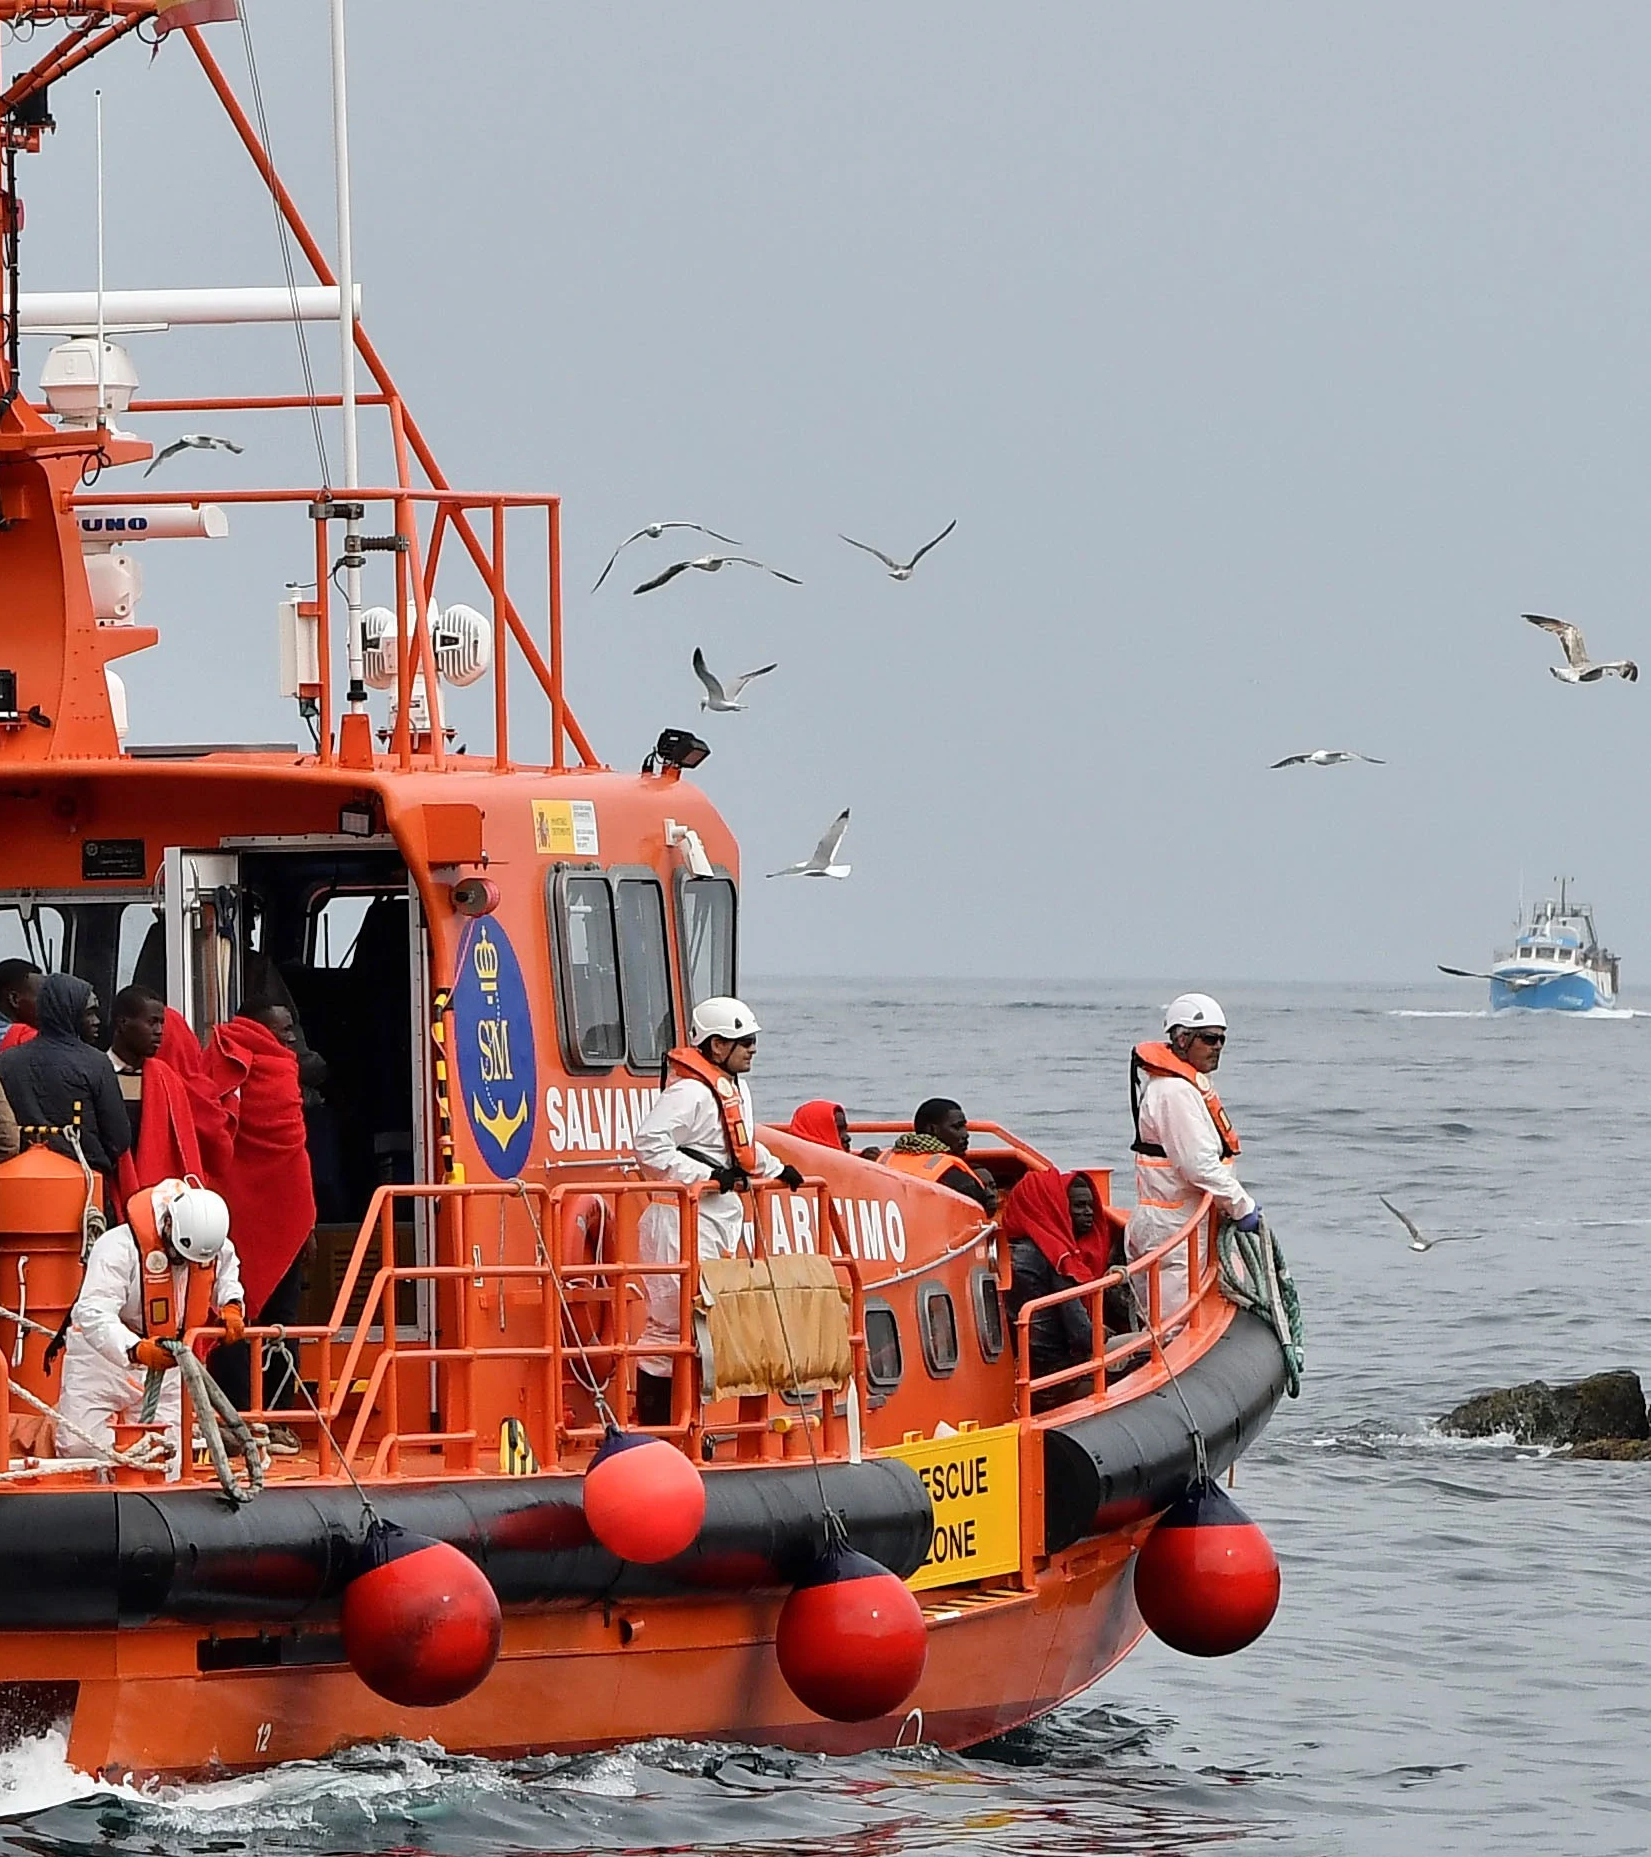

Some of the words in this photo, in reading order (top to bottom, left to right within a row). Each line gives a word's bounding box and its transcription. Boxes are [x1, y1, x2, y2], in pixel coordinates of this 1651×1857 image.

[79, 517, 148, 532] UNO
[478, 1020, 513, 1081] SM
[546, 1086, 661, 1152] SALVAM
[918, 1456, 989, 1502] ESCUE
[255, 1722, 272, 1753] 12
